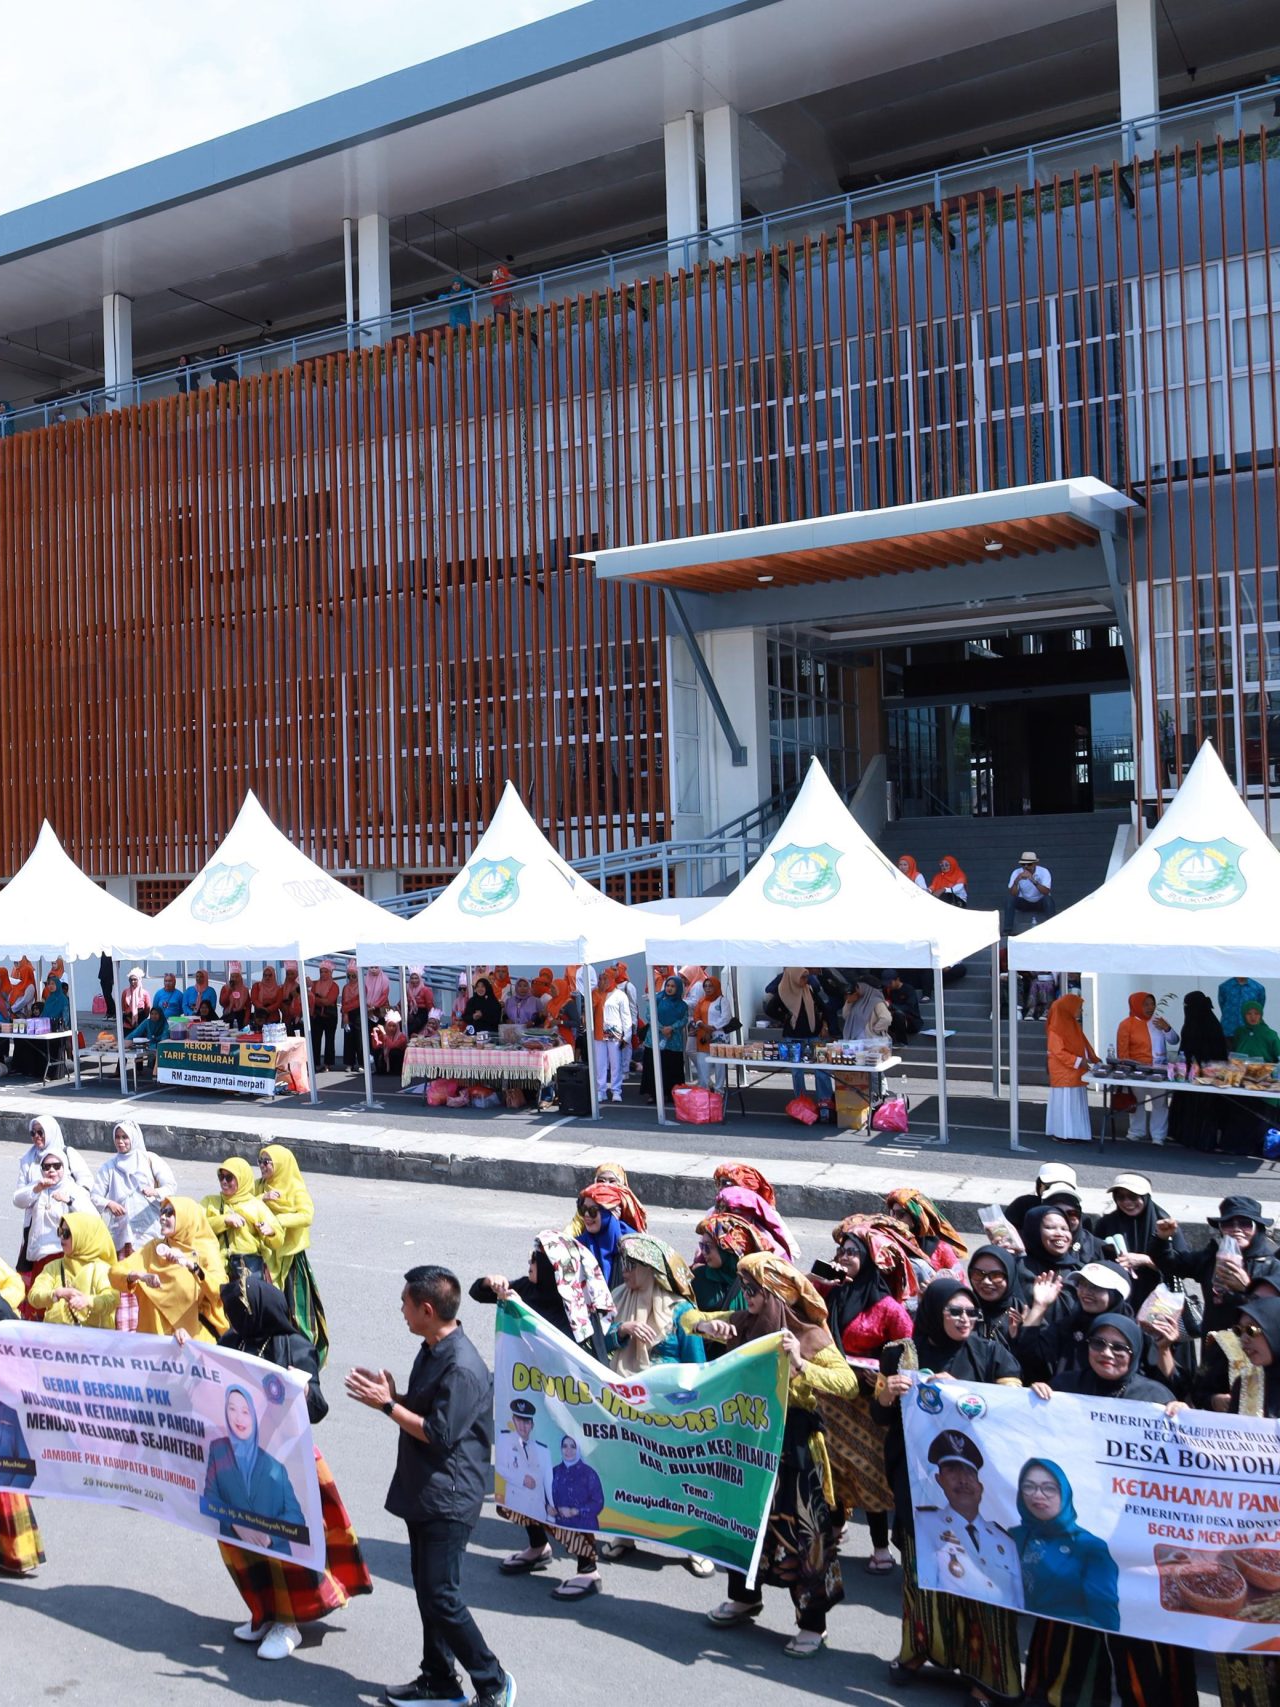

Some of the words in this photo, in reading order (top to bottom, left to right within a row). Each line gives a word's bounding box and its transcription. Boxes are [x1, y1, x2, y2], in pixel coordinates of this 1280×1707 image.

[163, 1050, 186, 1060] TARIF
[188, 1053, 234, 1065] TERMURAH
[184, 1042, 212, 1051] REKOR
[172, 1071, 182, 1080] RM
[185, 1073, 211, 1084] zamzam
[213, 1076, 235, 1087] pantai
[237, 1079, 265, 1090] merpati
[20, 1346, 126, 1369] KECAMATAN
[130, 1358, 184, 1375] RILAU
[191, 1365, 222, 1383] ALE
[42, 1376, 81, 1395] GERAK
[82, 1381, 144, 1403] BERSAMA
[146, 1388, 172, 1407] PKK
[21, 1389, 83, 1416] WUJUDKAN
[84, 1401, 156, 1427] KETAHANAN
[158, 1411, 206, 1439] PANGAN
[721, 1393, 769, 1430] PKK
[1090, 1411, 1178, 1432] PEMERINTAH
[1179, 1424, 1242, 1440] KABUPATEN
[26, 1412, 77, 1433] MENUJU
[78, 1421, 139, 1445] KELUARGA
[142, 1431, 205, 1463] SEJAHTERA
[582, 1422, 619, 1440] DESA
[620, 1427, 705, 1459] BATUKAROPA
[707, 1439, 735, 1459] KEC.
[736, 1442, 764, 1469] RILAU
[1105, 1439, 1171, 1466] DESA
[1144, 1430, 1218, 1449] KECAMATAN
[1218, 1441, 1255, 1451] RILAU
[41, 1448, 82, 1463] JAMBORE
[84, 1452, 101, 1466] PKK
[103, 1455, 149, 1476] KABUPATEN
[150, 1465, 197, 1491] BULUKUMBA
[639, 1451, 668, 1475] KAB.
[669, 1461, 744, 1487] BULUKUMBA
[83, 1476, 94, 1486] 29
[96, 1479, 142, 1495] November
[681, 1483, 709, 1499] Tema
[1111, 1477, 1233, 1509] KETAHANAN
[1238, 1491, 1280, 1513] PAN
[614, 1490, 685, 1514] Mewujudkan
[687, 1504, 729, 1529] Pertanian
[1124, 1503, 1204, 1524] PEMERINTAH
[1205, 1515, 1234, 1528] DESA
[1148, 1523, 1194, 1541] BERAS
[1197, 1529, 1249, 1545] MERAH
